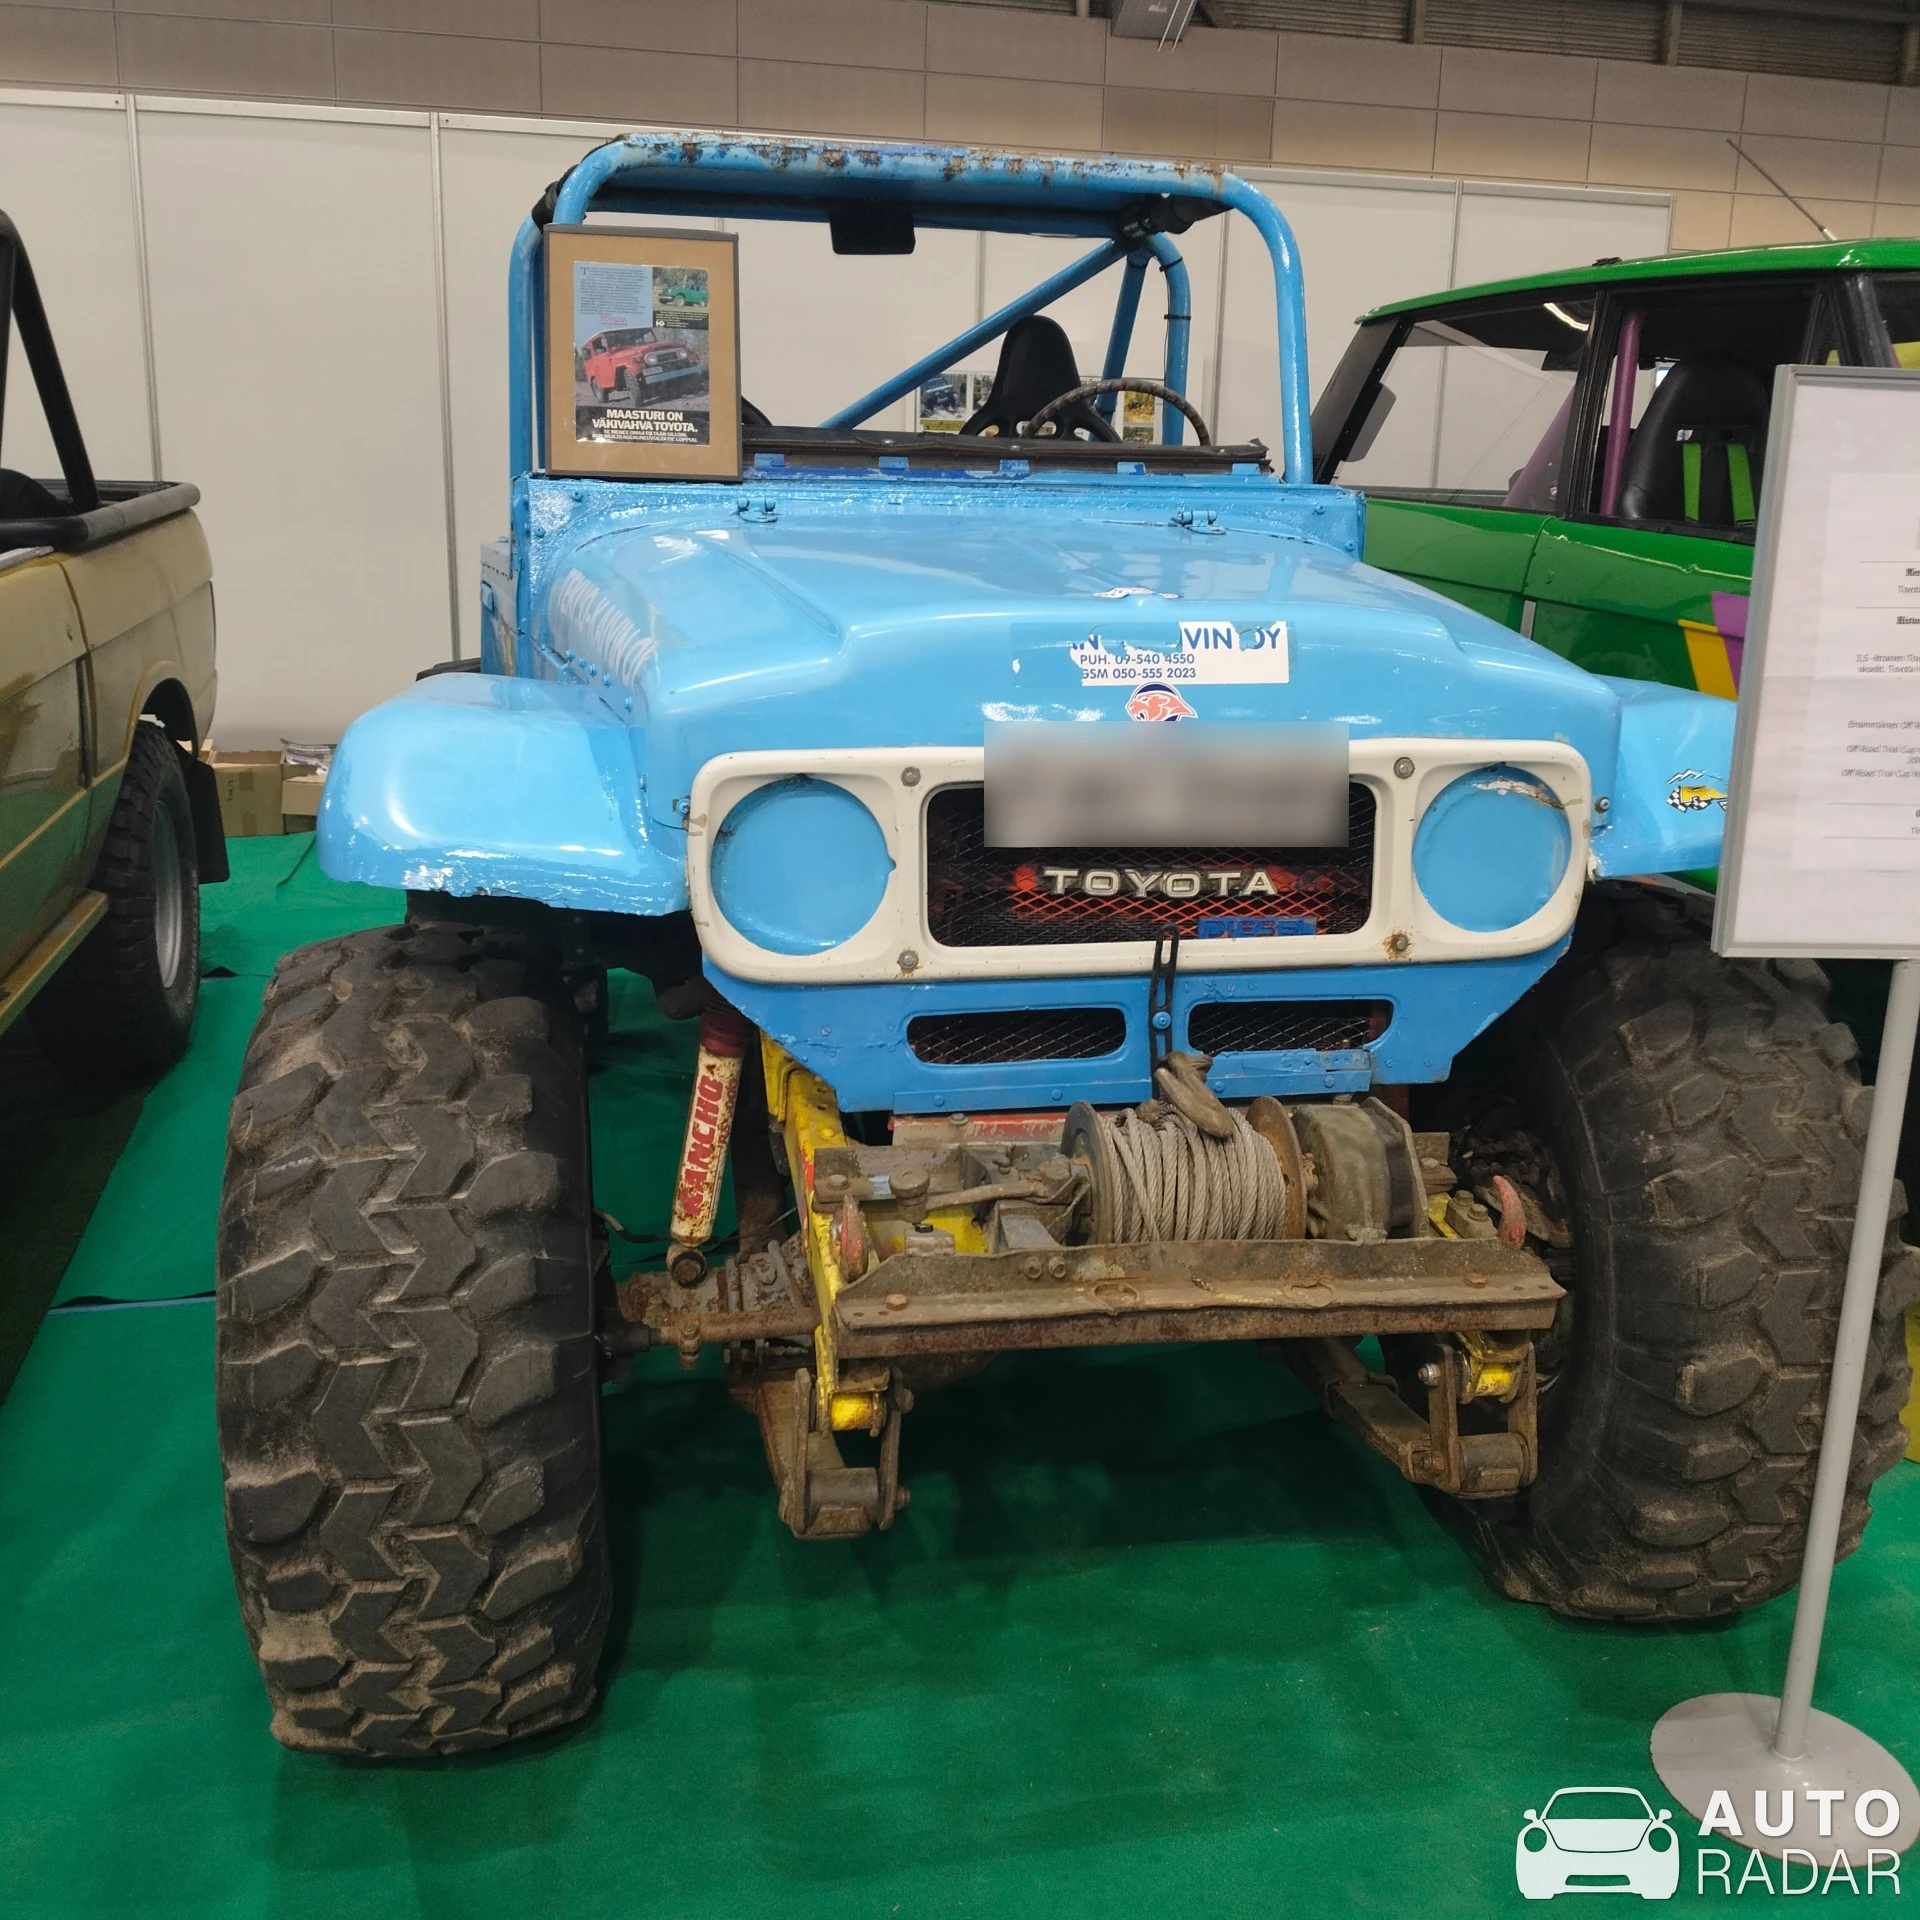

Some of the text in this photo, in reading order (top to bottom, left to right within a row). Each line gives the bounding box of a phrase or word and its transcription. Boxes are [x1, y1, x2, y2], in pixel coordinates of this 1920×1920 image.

[606, 409, 683, 421] MAASTURI ON
[592, 417, 699, 432] VÄKIVAHVA TOYOTA.
[1080, 653, 1195, 665] PUH. 09-540 4550
[1113, 667, 1162, 679] 050-555
[1167, 667, 1197, 679] 2023
[1043, 867, 1278, 898] TOYOTA
[1199, 917, 1316, 939] DIESEL
[681, 1074, 724, 1217] RANCHO
